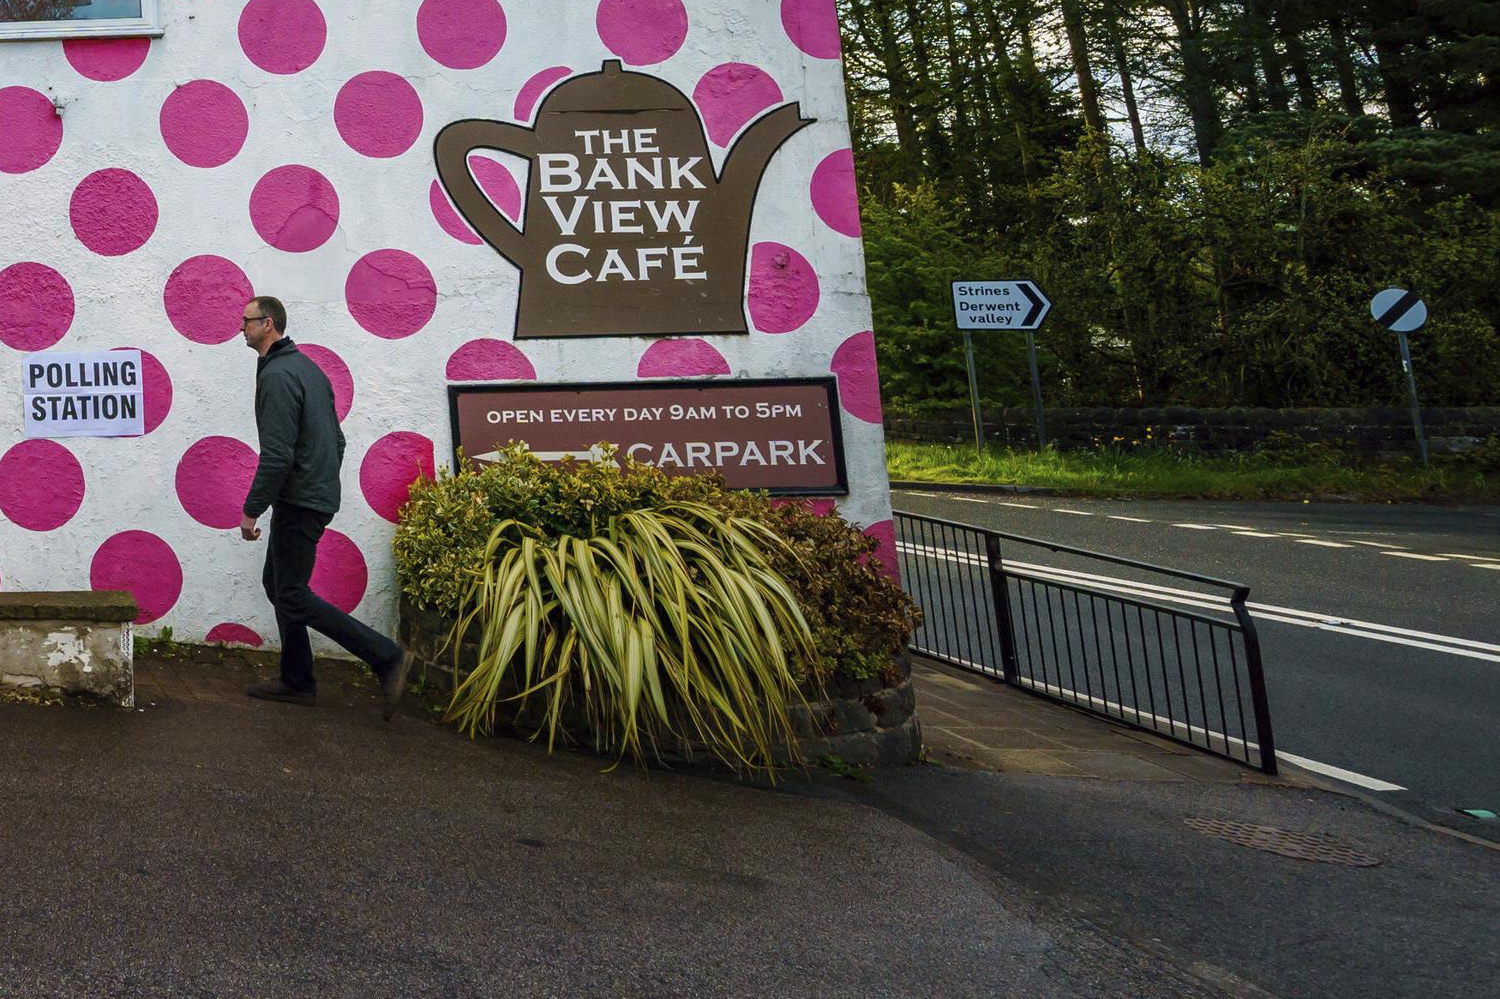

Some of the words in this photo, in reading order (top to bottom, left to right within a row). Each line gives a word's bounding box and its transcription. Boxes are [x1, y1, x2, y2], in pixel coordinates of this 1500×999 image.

[574, 128, 660, 155] THE
[536, 153, 707, 193] BANK
[542, 195, 701, 236] VIEW
[545, 235, 708, 285] CAFÉ
[958, 286, 1010, 296] Strines
[959, 301, 1021, 312] Derwent
[969, 313, 1013, 326] valley
[29, 361, 137, 388] POLLING
[31, 394, 137, 422] STATION
[487, 409, 544, 424] OPEN
[550, 408, 618, 423] EVERY
[623, 407, 665, 421] DAY
[669, 404, 719, 420] 9AM
[722, 405, 750, 419] TO
[755, 402, 802, 418] 5PM
[626, 439, 826, 467] CARPARK
